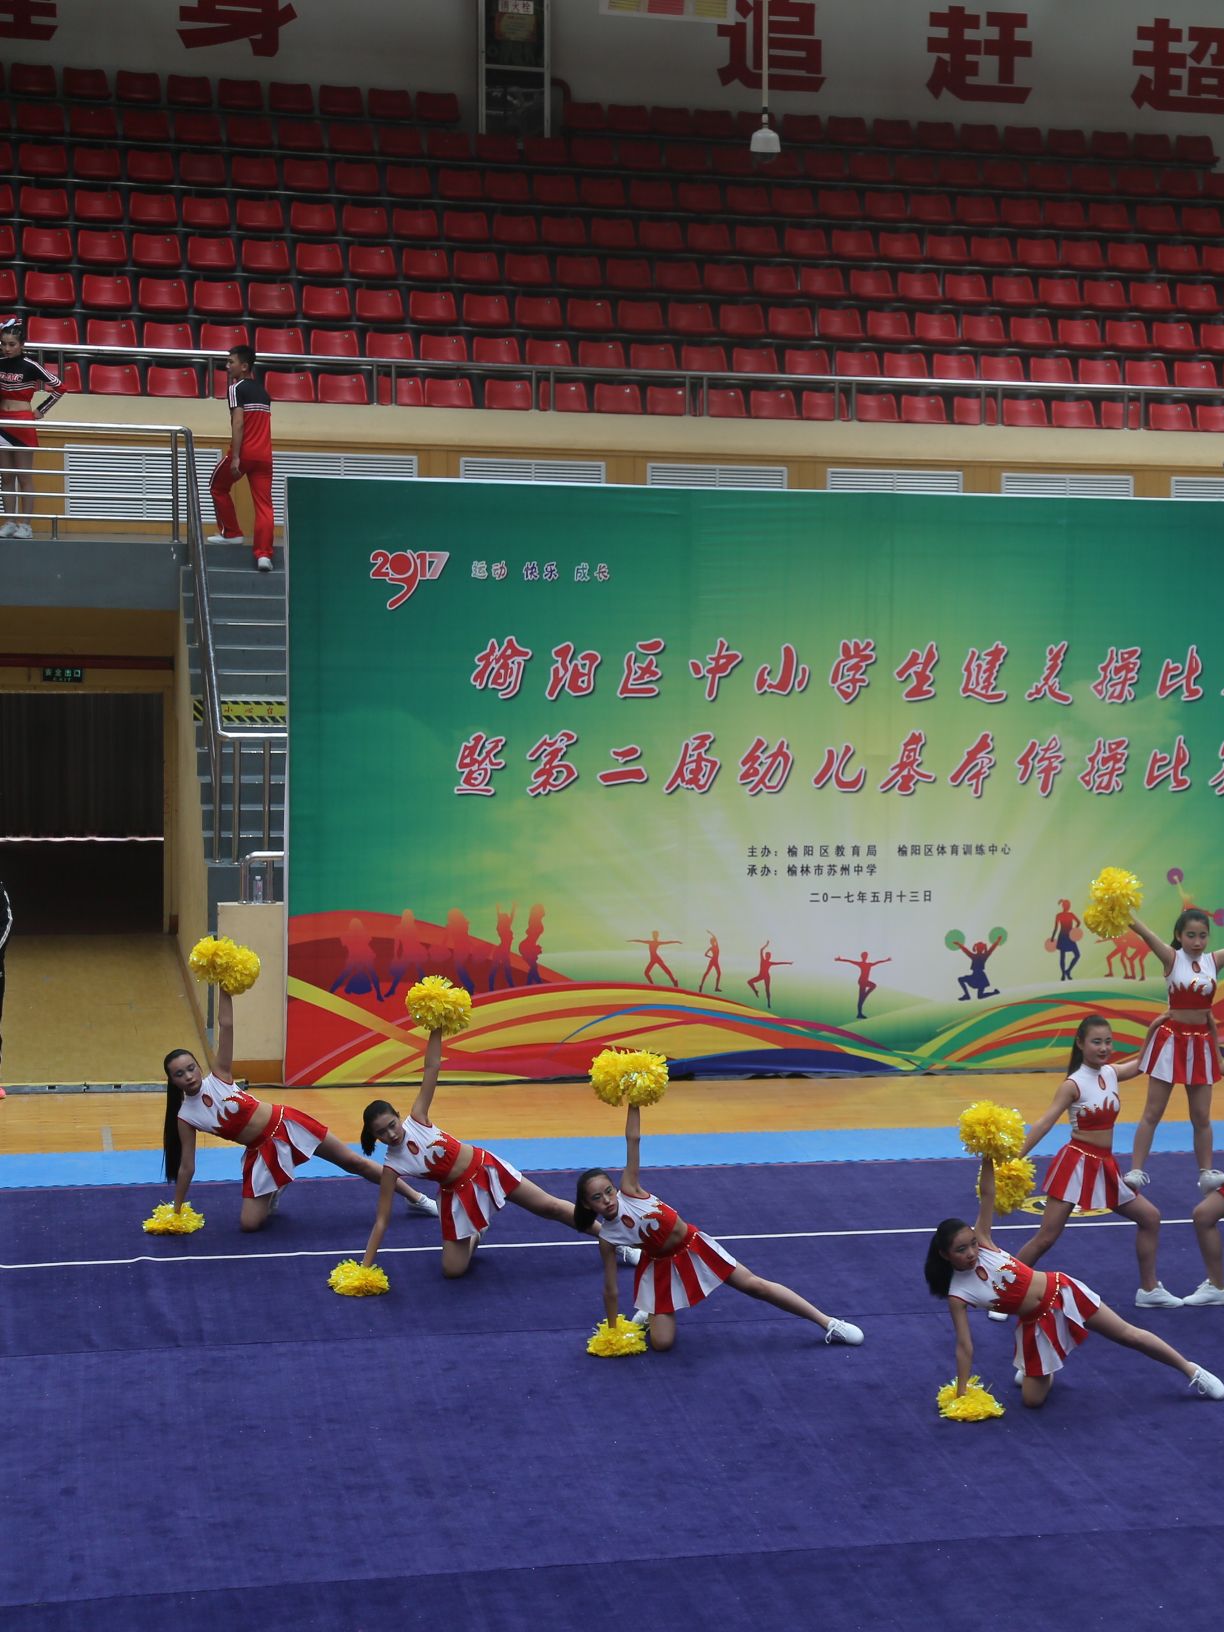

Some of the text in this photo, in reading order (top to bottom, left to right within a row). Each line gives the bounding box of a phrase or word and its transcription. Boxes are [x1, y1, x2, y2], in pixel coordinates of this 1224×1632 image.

[470, 561, 610, 581] 运动 快乐 成长
[896, 843, 1012, 857] 榆阳区体育训练中心
